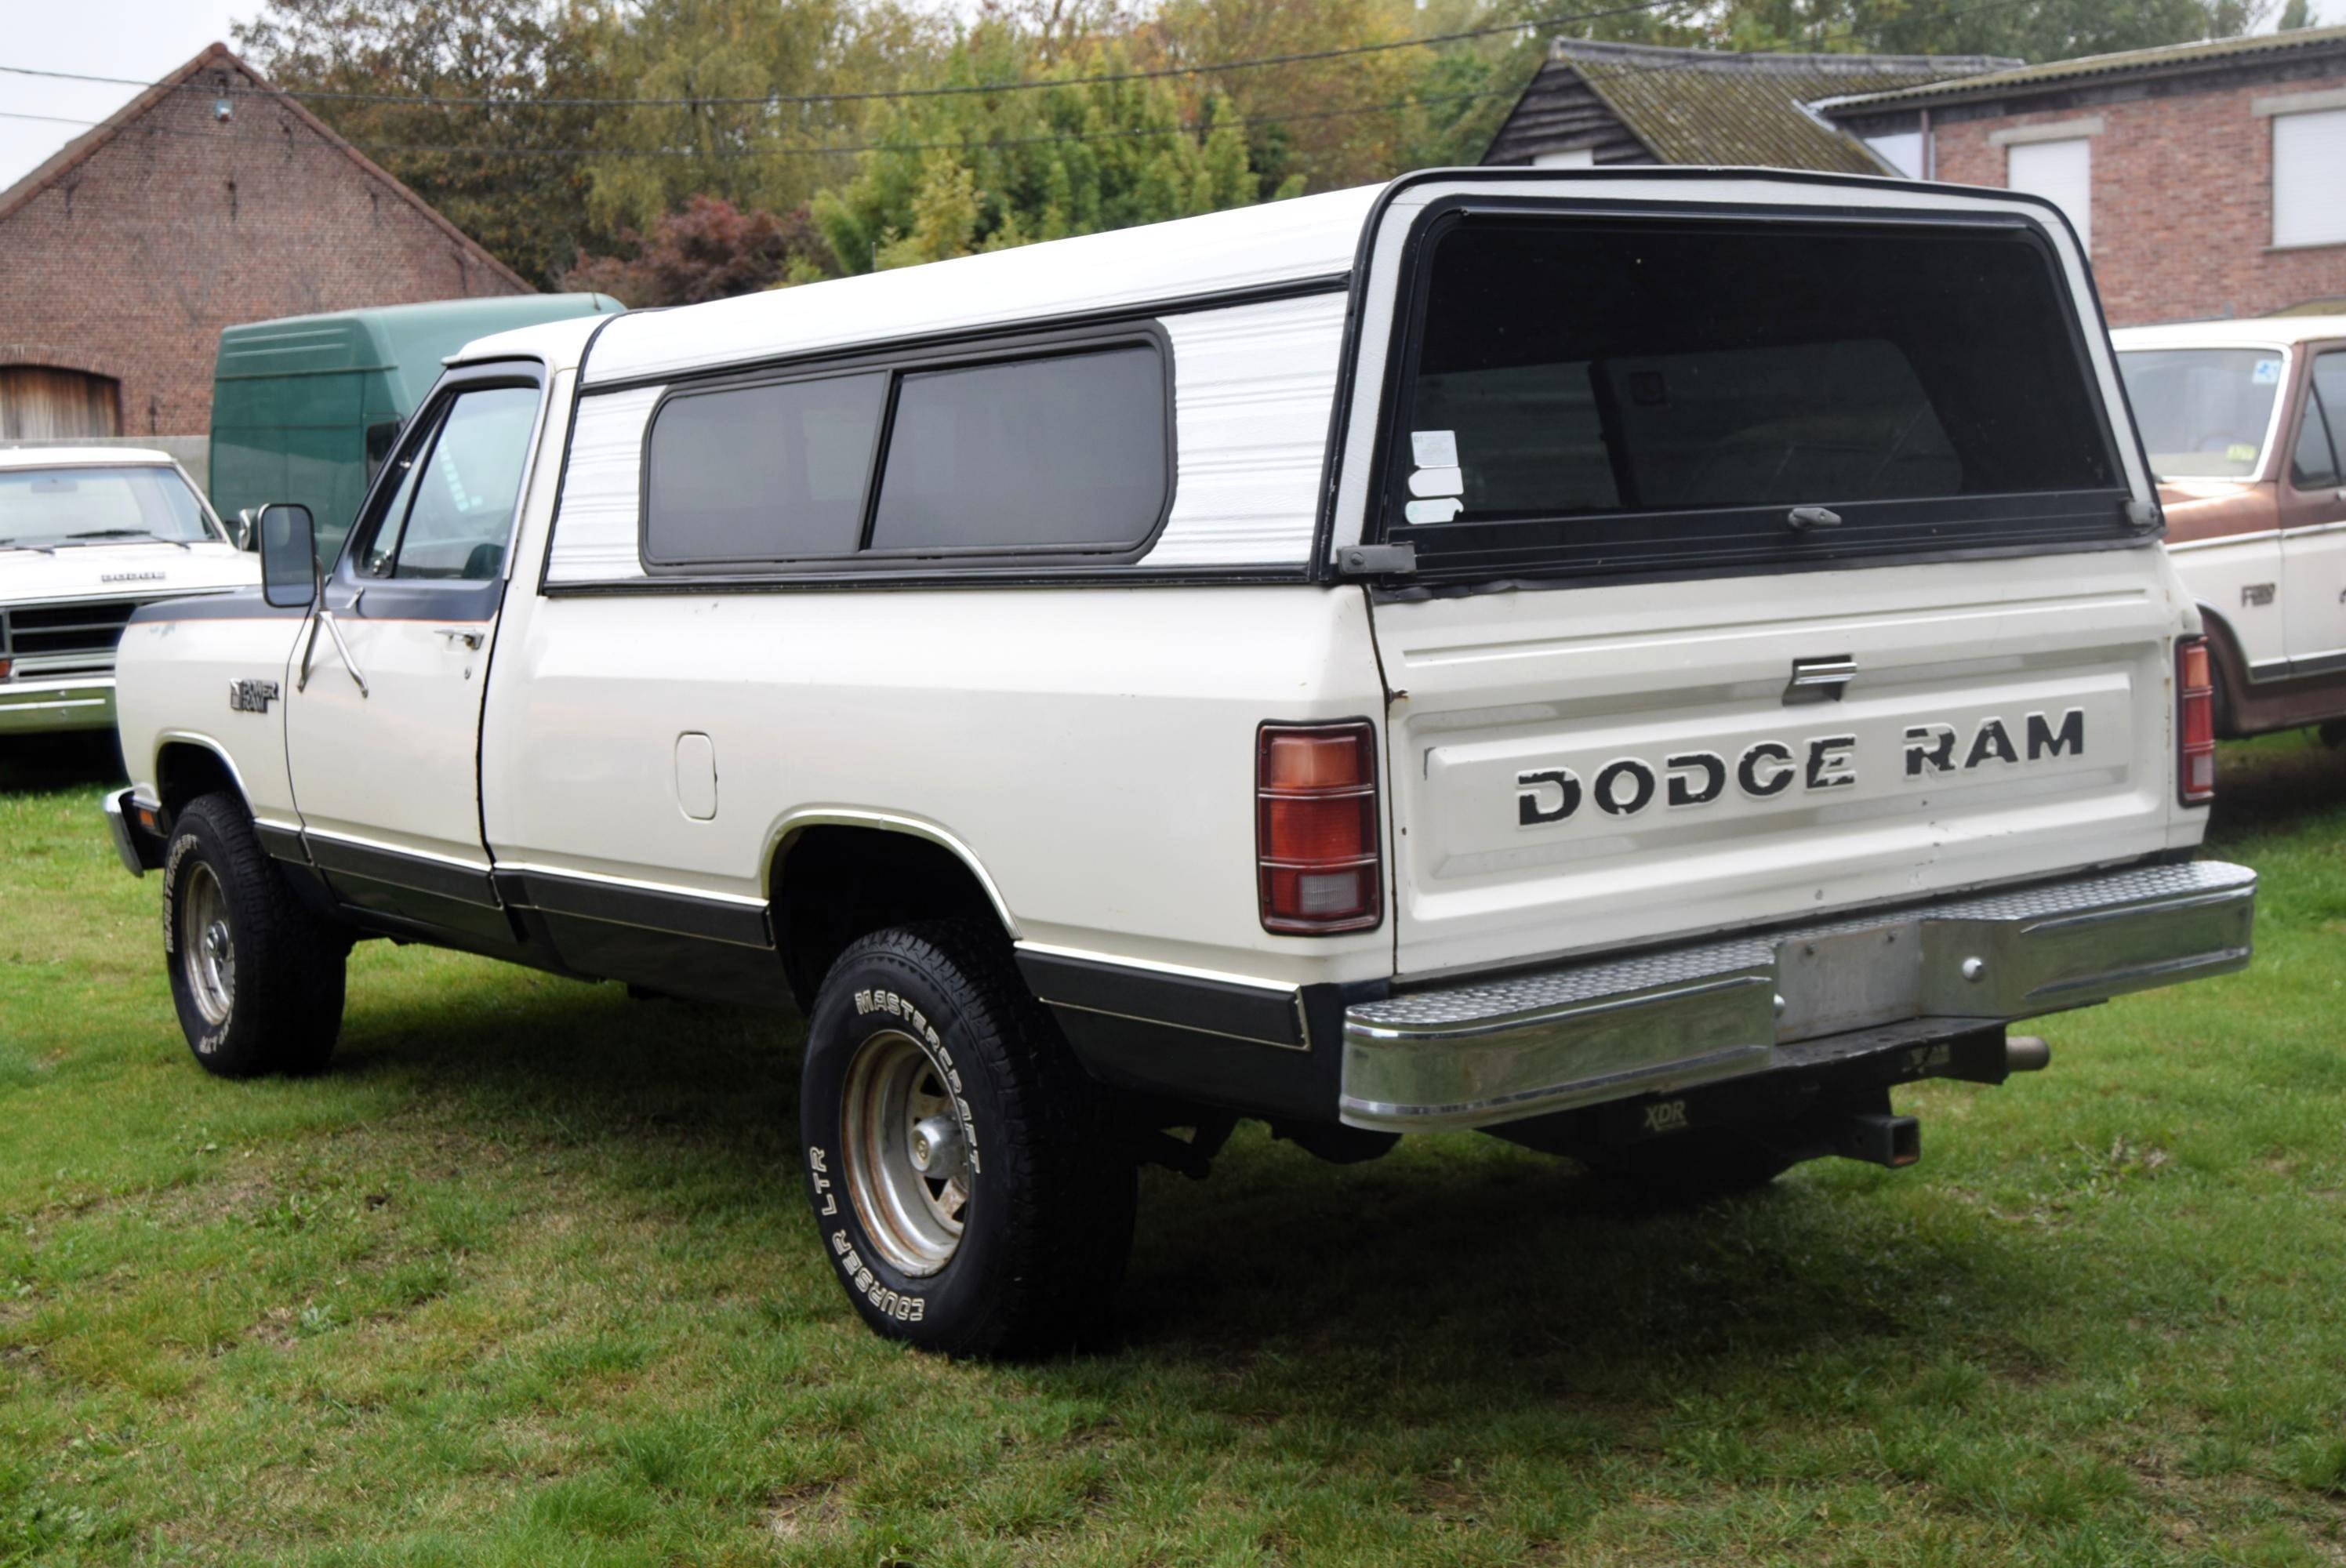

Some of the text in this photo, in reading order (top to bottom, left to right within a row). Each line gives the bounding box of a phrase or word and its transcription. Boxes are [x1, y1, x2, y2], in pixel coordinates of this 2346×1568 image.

[1515, 707, 2086, 828] DODGE RAM
[855, 989, 981, 1174] MASTERCRAFT
[809, 1146, 925, 1321] COURSER LTR
